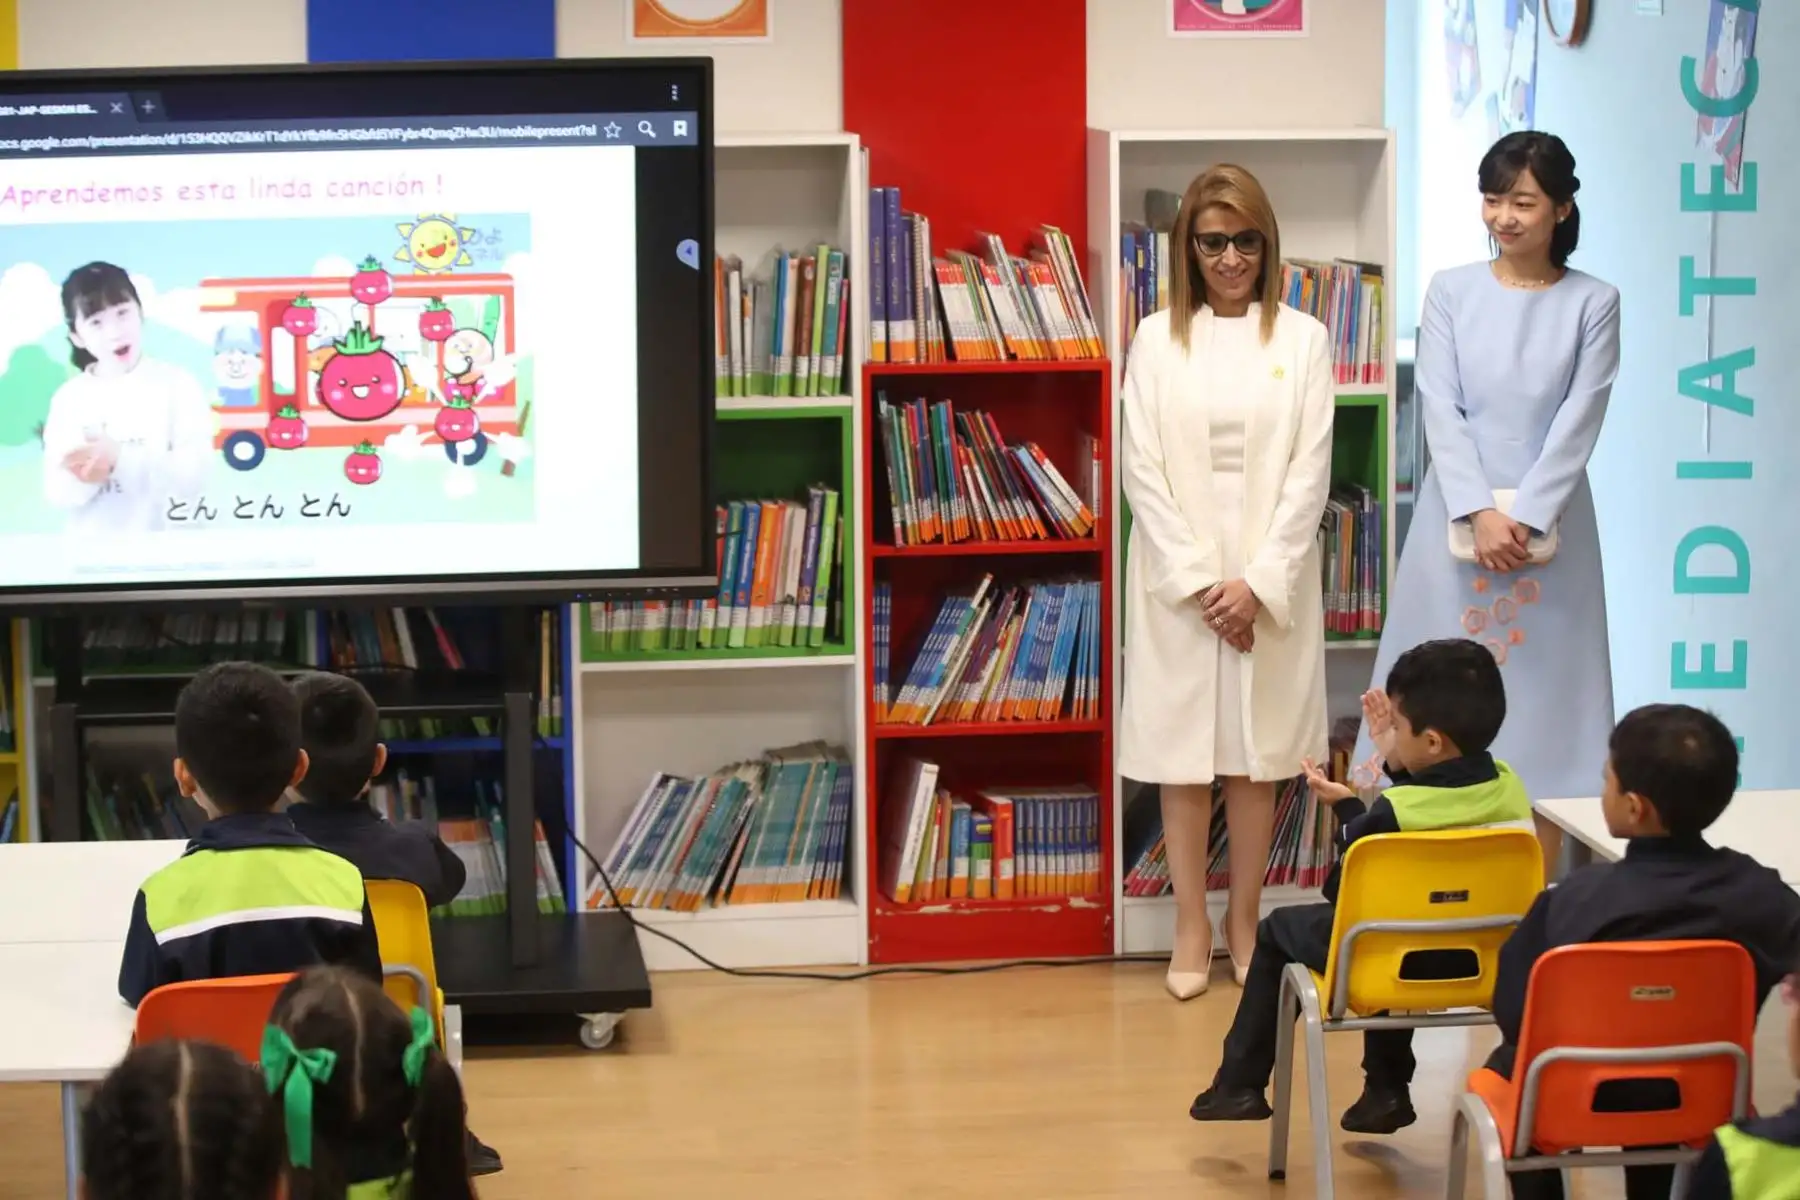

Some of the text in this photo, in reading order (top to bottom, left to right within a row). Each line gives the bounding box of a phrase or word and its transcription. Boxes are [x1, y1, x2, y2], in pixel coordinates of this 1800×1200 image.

[3, 180, 162, 212] Aprendemos
[177, 181, 235, 201] esta
[250, 174, 312, 199] linda
[326, 172, 423, 198] canción
[1670, 0, 1759, 787] EDIATEC
[167, 492, 351, 520] とん とん とん
